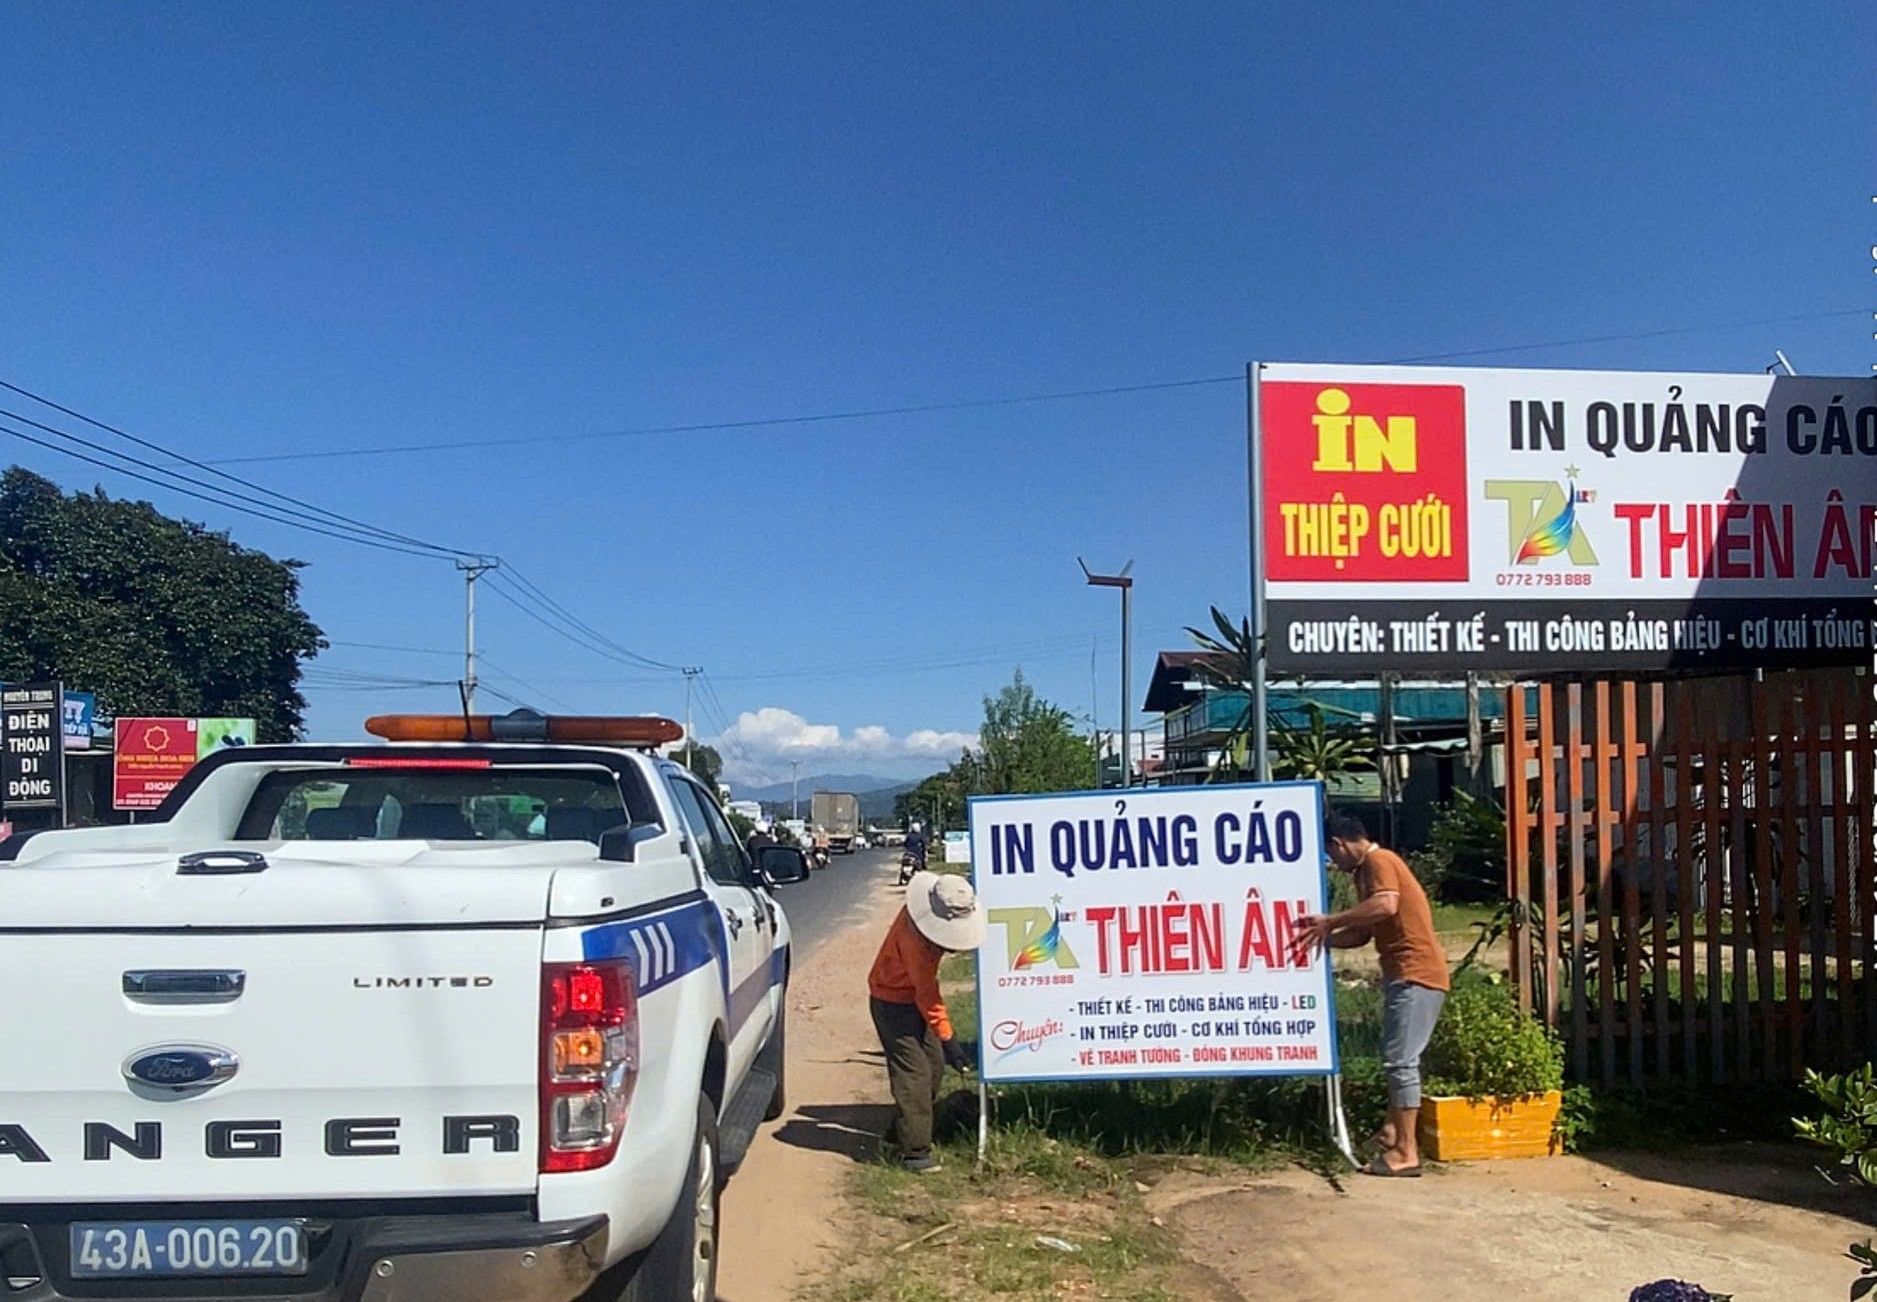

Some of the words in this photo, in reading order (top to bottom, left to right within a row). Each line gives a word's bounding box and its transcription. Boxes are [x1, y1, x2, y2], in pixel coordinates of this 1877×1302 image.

[1510, 399, 1565, 451] IN
[1587, 386, 1767, 457] QUẢNG
[1280, 492, 1369, 569] THIỆP
[1379, 493, 1451, 557] CƯỚI
[1614, 489, 1795, 579] THIÊN
[1496, 574, 1533, 586] 0772
[1536, 574, 1562, 586] 793
[1565, 574, 1592, 586] 888
[1288, 615, 1385, 653] CHUYÊN:
[1389, 611, 1451, 652] THIẾT
[1456, 611, 1486, 652] KẾ
[1504, 620, 1540, 651] THI
[1545, 614, 1605, 651] CÔNG
[1609, 610, 1669, 651] BẢNG
[1673, 614, 1721, 656] HIỆU
[1741, 616, 1769, 649] CƠ
[1774, 613, 1808, 649] KHÍ
[1812, 608, 1865, 649] TỔNG
[8, 710, 50, 734] ĐIỆN
[8, 736, 50, 757] THOẠI
[21, 757, 38, 773] DI
[9, 776, 51, 800] ĐỘNG
[990, 823, 1035, 875] IN
[1050, 799, 1199, 878] QUẢNG
[1214, 800, 1304, 865] CÁO
[1086, 889, 1224, 974] THIÊN
[1238, 886, 1310, 970] ÂN
[354, 976, 494, 988] LIMITED
[998, 976, 1028, 987] 0772
[1030, 975, 1050, 986] 793
[1078, 995, 1113, 1016] THIẾT
[1116, 994, 1133, 1015] KẾ
[1145, 998, 1165, 1014] THI
[1169, 995, 1205, 1013] CÔNG
[1209, 992, 1244, 1012] BẢNG
[1249, 992, 1279, 1014] HIỆU
[1292, 995, 1316, 1010] LED
[1080, 1026, 1095, 1041] IN
[1100, 1021, 1138, 1043] THIỆP
[1144, 1021, 1177, 1039] CƯỚI
[1192, 1021, 1211, 1037] CƠ
[1215, 1018, 1239, 1037] KHÍ
[1243, 1015, 1282, 1035] TỔNG
[1286, 1019, 1316, 1038] HỢP
[1098, 1049, 1137, 1065] TRANH
[1230, 1047, 1273, 1061] KHUNG
[1276, 1045, 1318, 1061] TRANH
[147, 1056, 195, 1081] Ford
[79, 1226, 300, 1272] 43A-006.20
